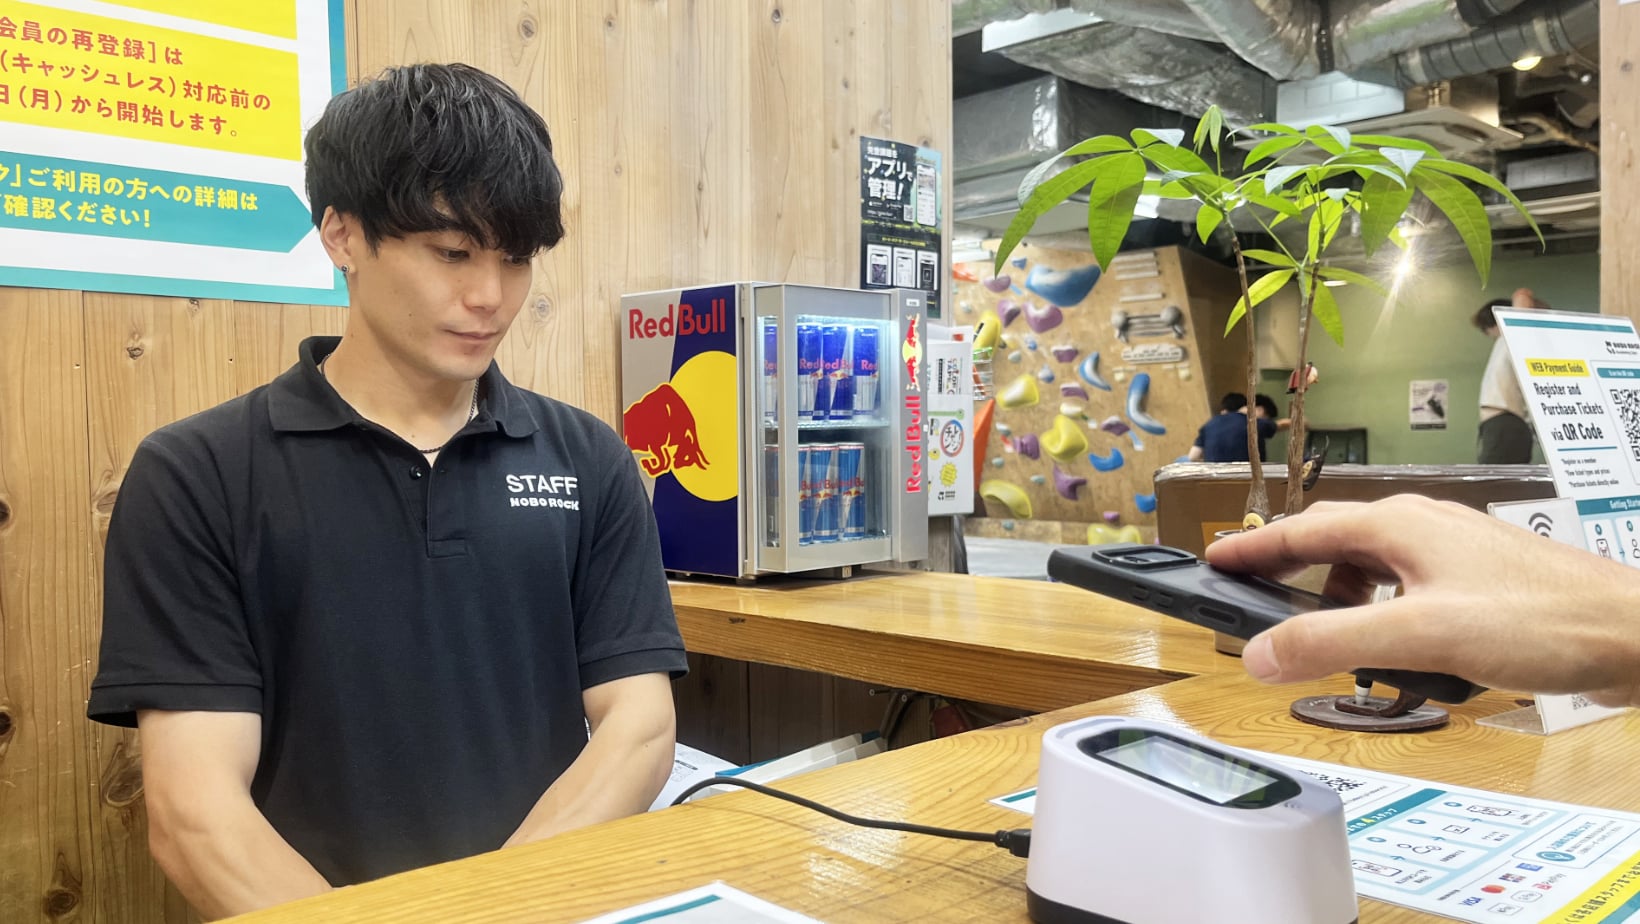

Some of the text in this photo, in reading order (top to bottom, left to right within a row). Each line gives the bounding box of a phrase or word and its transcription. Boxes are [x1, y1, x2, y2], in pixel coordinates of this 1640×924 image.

[867, 156, 913, 182] アプリで
[0, 193, 151, 228] 確認ください！
[629, 298, 726, 340] Red Bull
[1545, 362, 1569, 375] Payment
[1533, 382, 1582, 398] Register and
[1541, 402, 1604, 416] Purchase Tickets
[1551, 422, 1604, 441] via QR Code
[905, 396, 922, 492] Red Bull
[506, 474, 578, 495] STAFF
